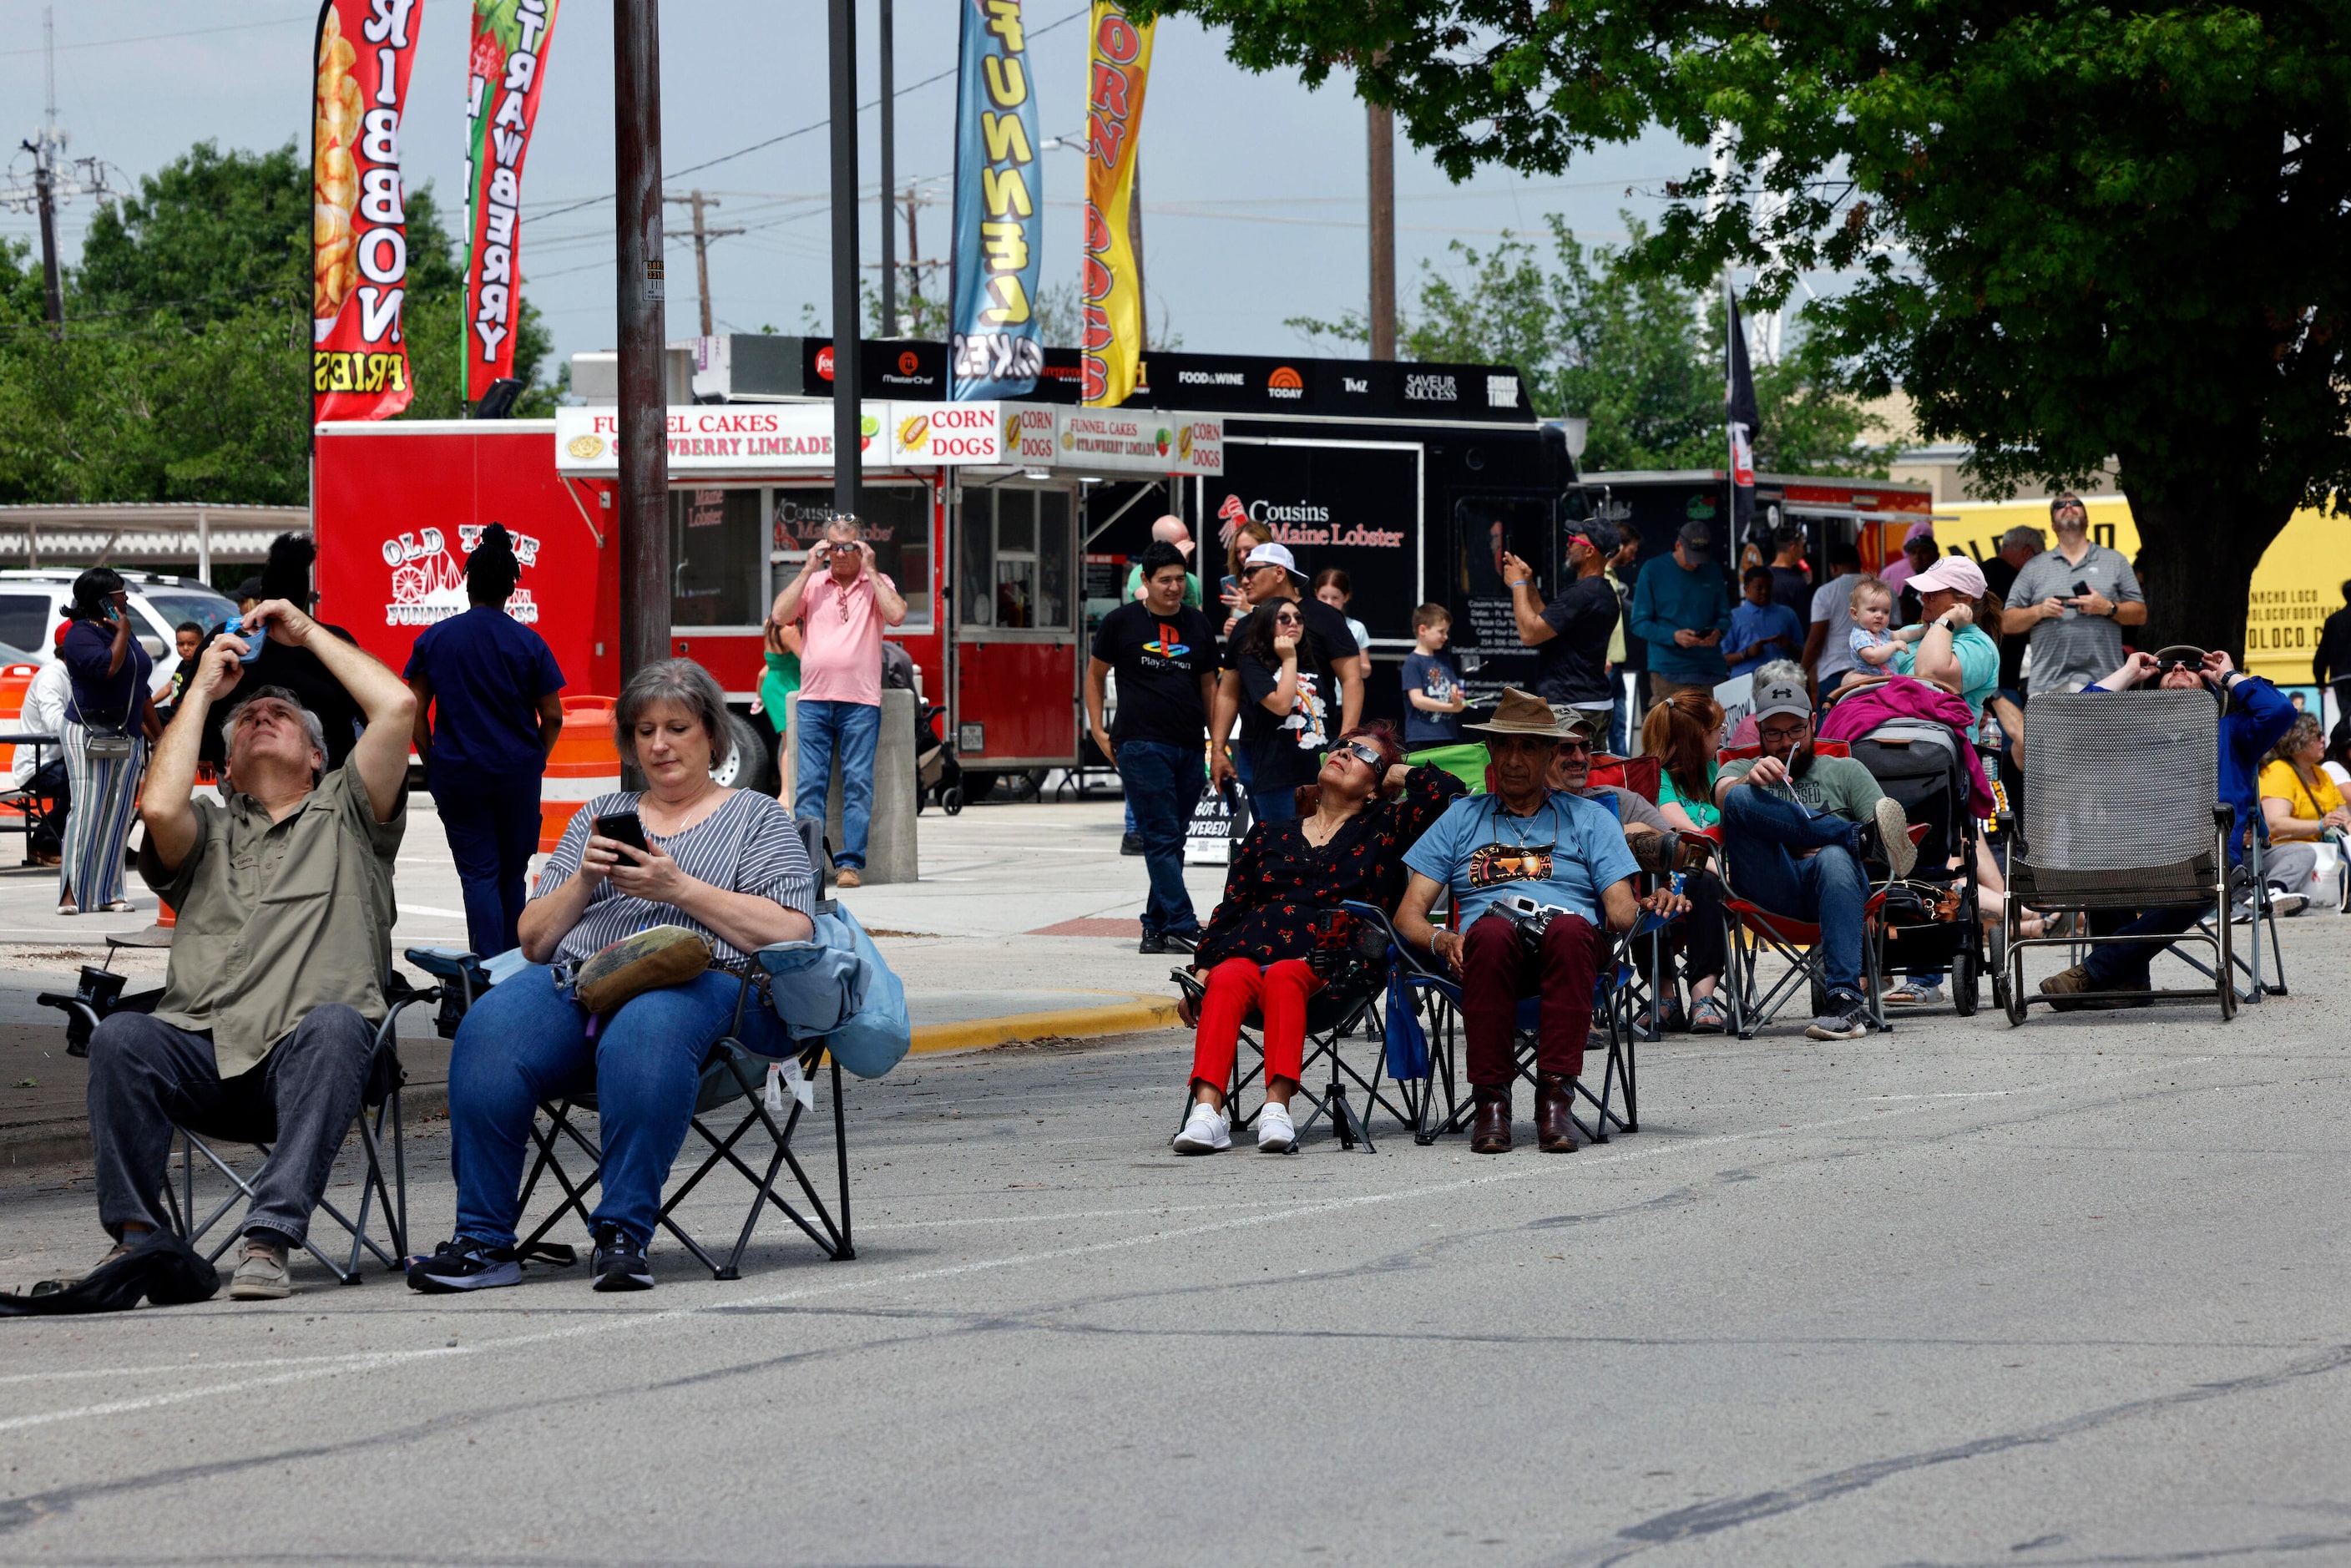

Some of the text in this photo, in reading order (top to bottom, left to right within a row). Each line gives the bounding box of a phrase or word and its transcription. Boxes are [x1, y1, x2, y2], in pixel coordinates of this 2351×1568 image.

[1089, 0, 1140, 168] ORN
[1268, 387, 1303, 399] TODAY
[699, 414, 778, 432] CAKES
[932, 410, 995, 428] CORN
[1021, 410, 1053, 429] CORN
[1070, 418, 1138, 437] FUNNEL CAKES
[1192, 422, 1221, 441] CORN
[747, 436, 833, 456] LIMEADE
[932, 438, 995, 456] DOGS
[1021, 438, 1053, 457] DOGS
[1192, 448, 1221, 468] DOGS
[1248, 499, 1330, 525] Cousins
[1268, 522, 1404, 548] Maine Lobster
[383, 527, 445, 567] OLD
